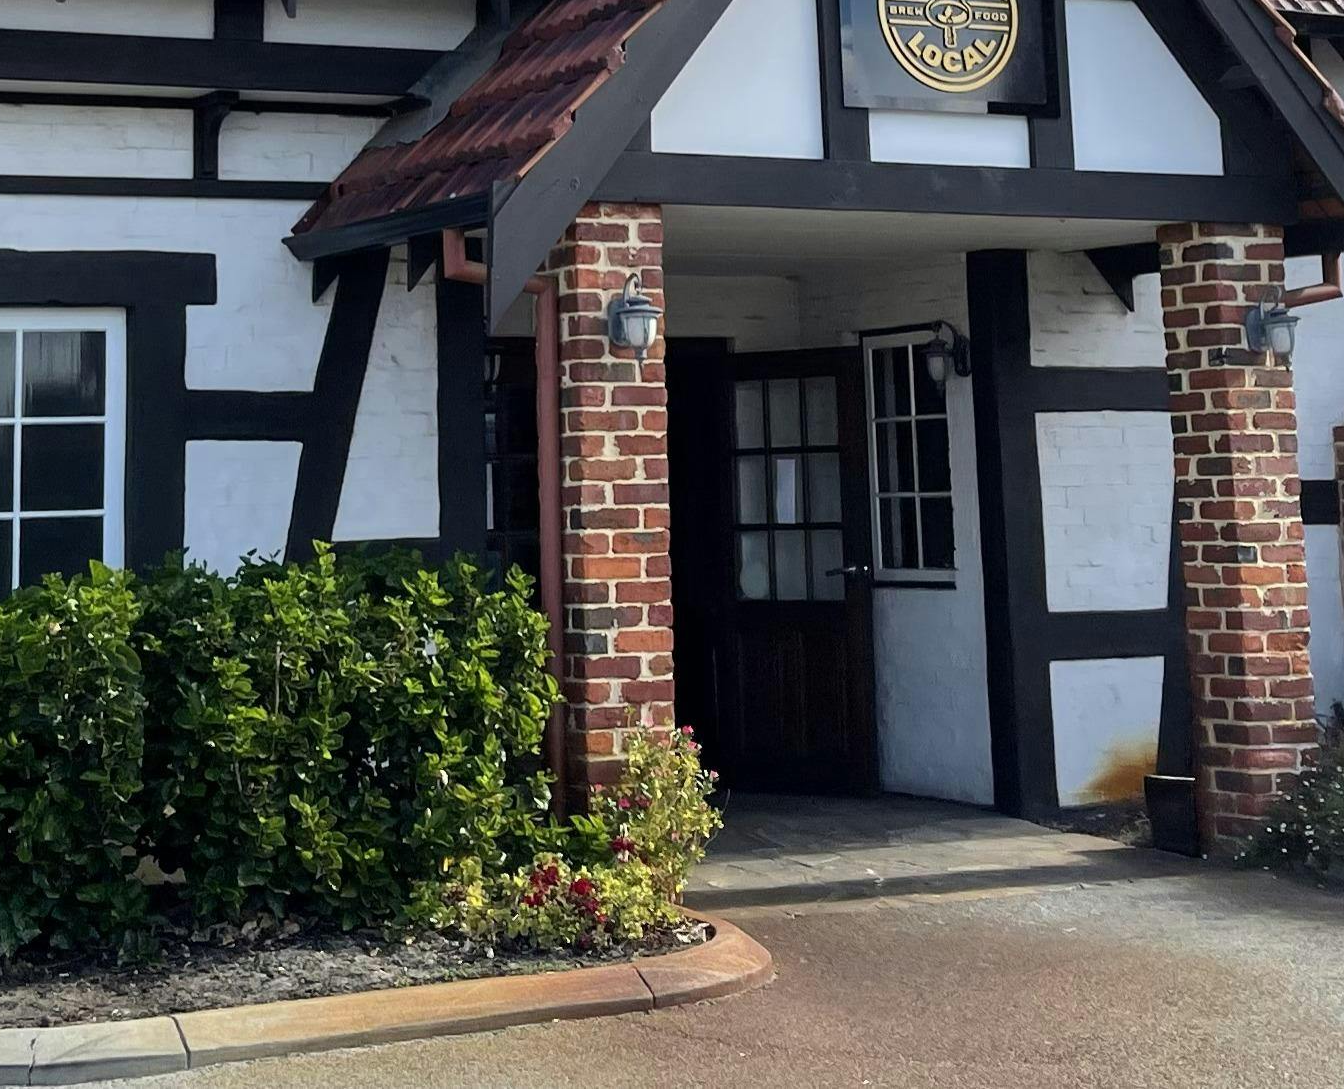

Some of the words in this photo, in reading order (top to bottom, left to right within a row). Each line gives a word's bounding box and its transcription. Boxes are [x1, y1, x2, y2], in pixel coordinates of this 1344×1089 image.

[889, 5, 923, 16] BREW
[974, 11, 1008, 22] FOOD
[907, 31, 996, 72] LOCAL
